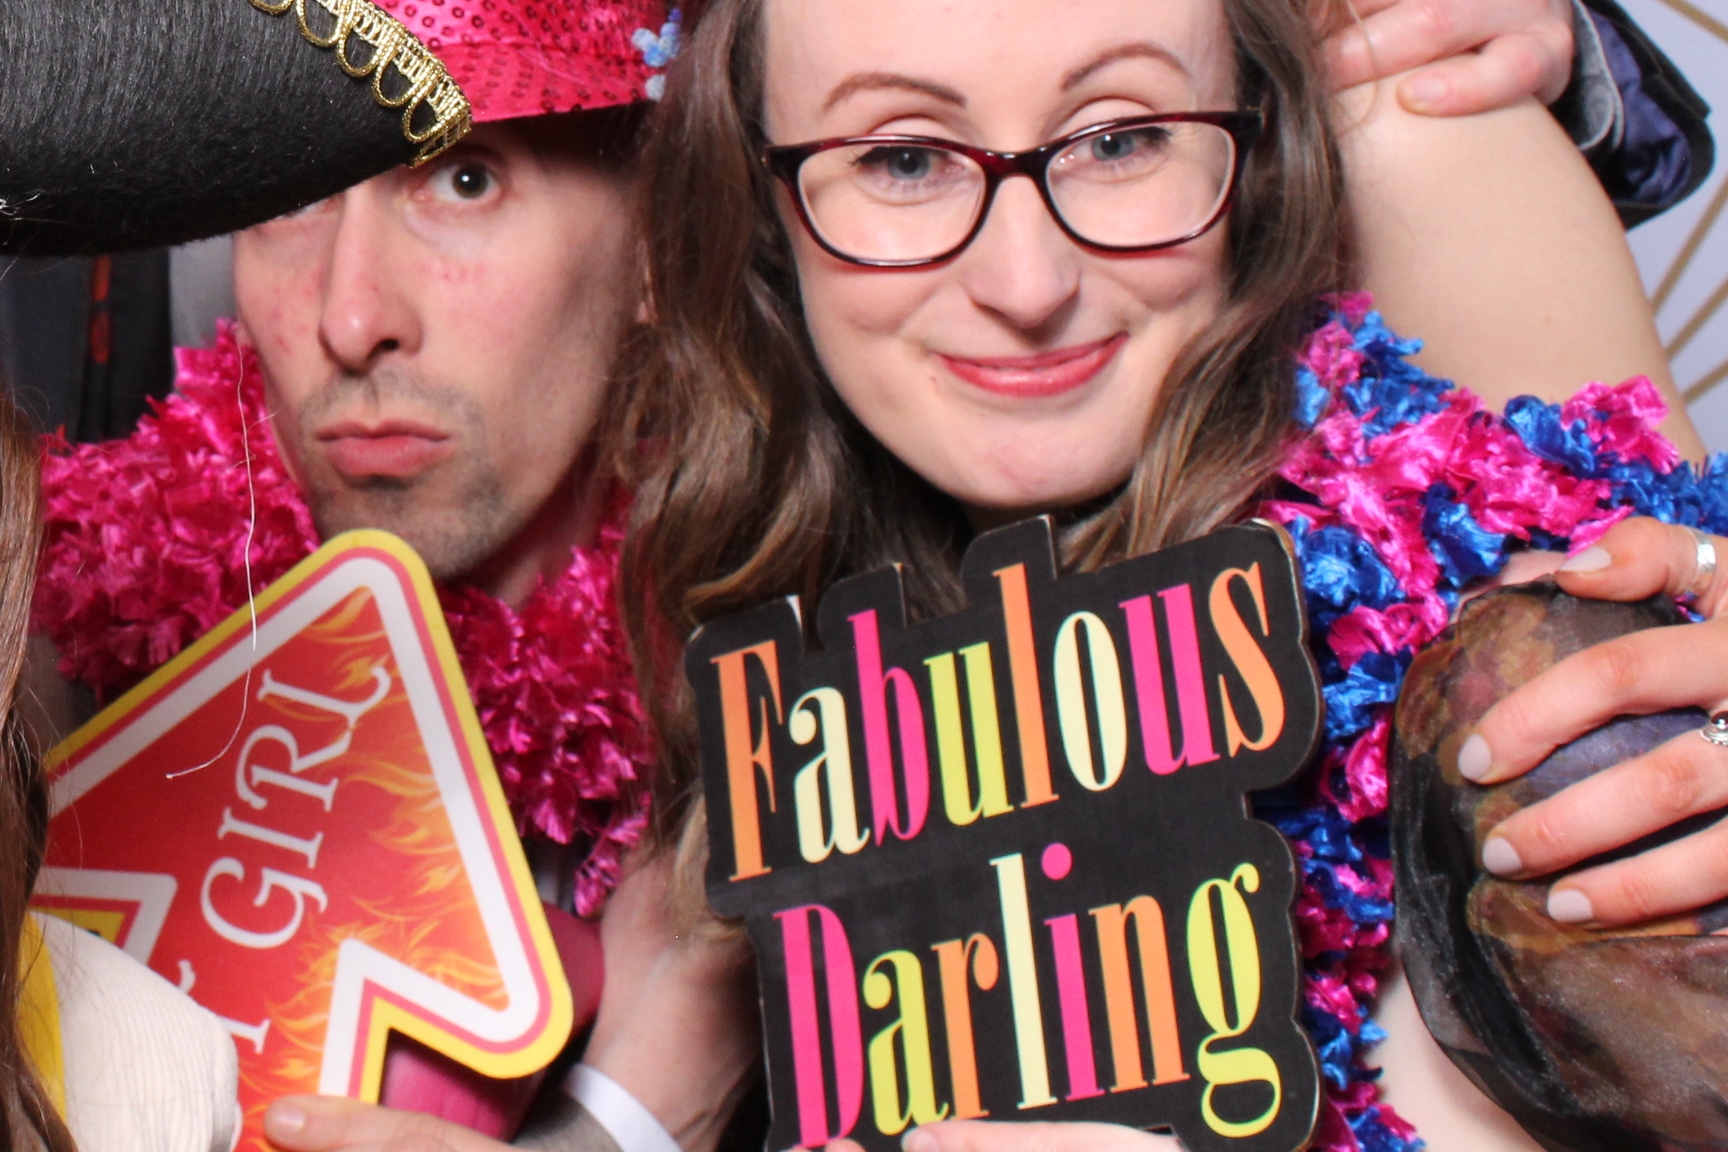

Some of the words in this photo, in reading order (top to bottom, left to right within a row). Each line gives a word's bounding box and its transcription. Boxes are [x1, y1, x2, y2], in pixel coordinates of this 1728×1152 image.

[200, 663, 391, 948] GIRL
[710, 561, 1285, 883] Fabulous
[773, 842, 1282, 1147] Darling
